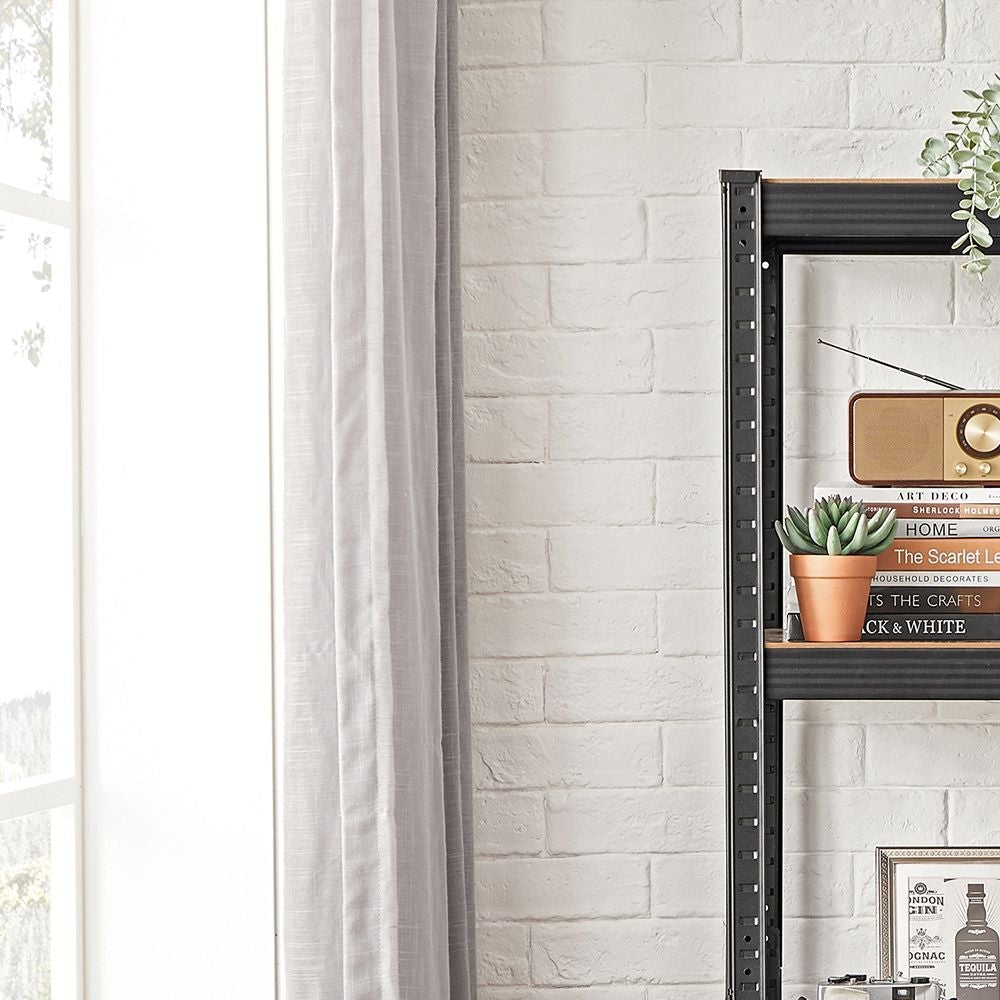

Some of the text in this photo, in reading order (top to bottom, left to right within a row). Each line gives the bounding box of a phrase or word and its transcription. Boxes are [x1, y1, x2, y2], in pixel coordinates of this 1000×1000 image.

[897, 491, 924, 501] ART
[931, 491, 968, 501] DECO
[912, 505, 1000, 515] SHERLOCK HOLMES
[906, 523, 958, 536] HOME
[894, 549, 924, 564] The
[928, 548, 981, 564] Scarlet
[873, 575, 930, 583] HOUSEHOLD
[933, 575, 989, 583] DECORATES
[890, 594, 920, 607] THE
[926, 594, 982, 607] CRAFTS
[862, 619, 966, 634] CK & WHITE
[958, 963, 998, 972] TEQUILA
